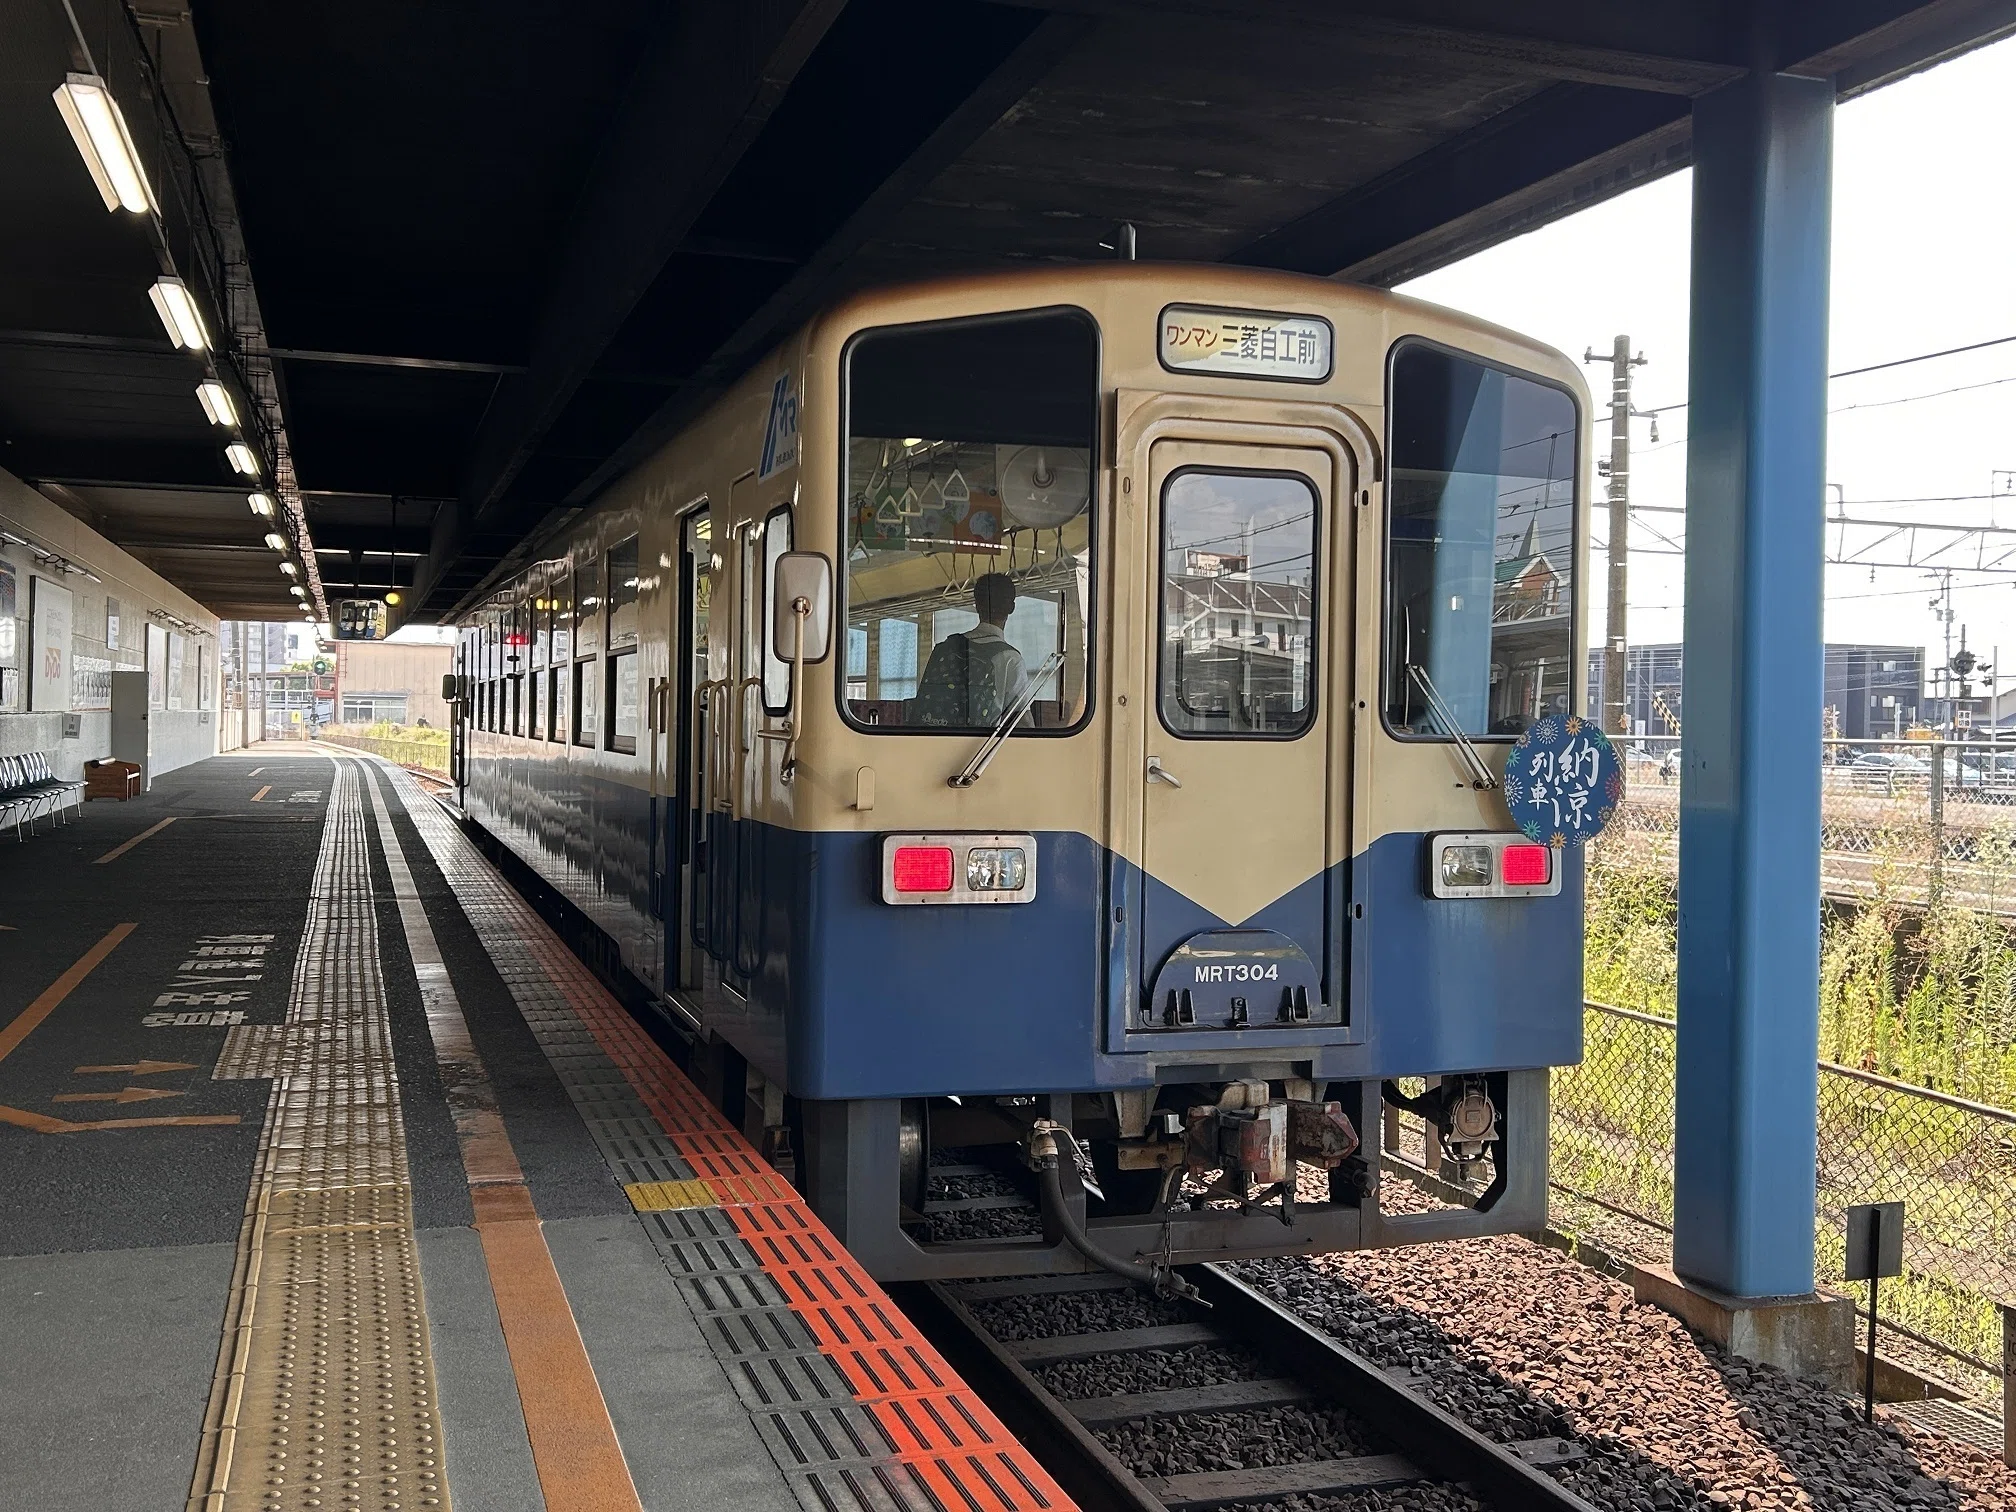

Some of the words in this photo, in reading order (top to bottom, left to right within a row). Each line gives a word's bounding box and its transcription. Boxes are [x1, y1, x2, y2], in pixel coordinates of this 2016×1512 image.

[1166, 325, 1218, 349] ワンマン
[1220, 324, 1317, 365] 三菱自工前
[1528, 751, 1554, 811] 列車
[1551, 737, 1600, 830] 納涼
[1194, 963, 1279, 983] MRT304
